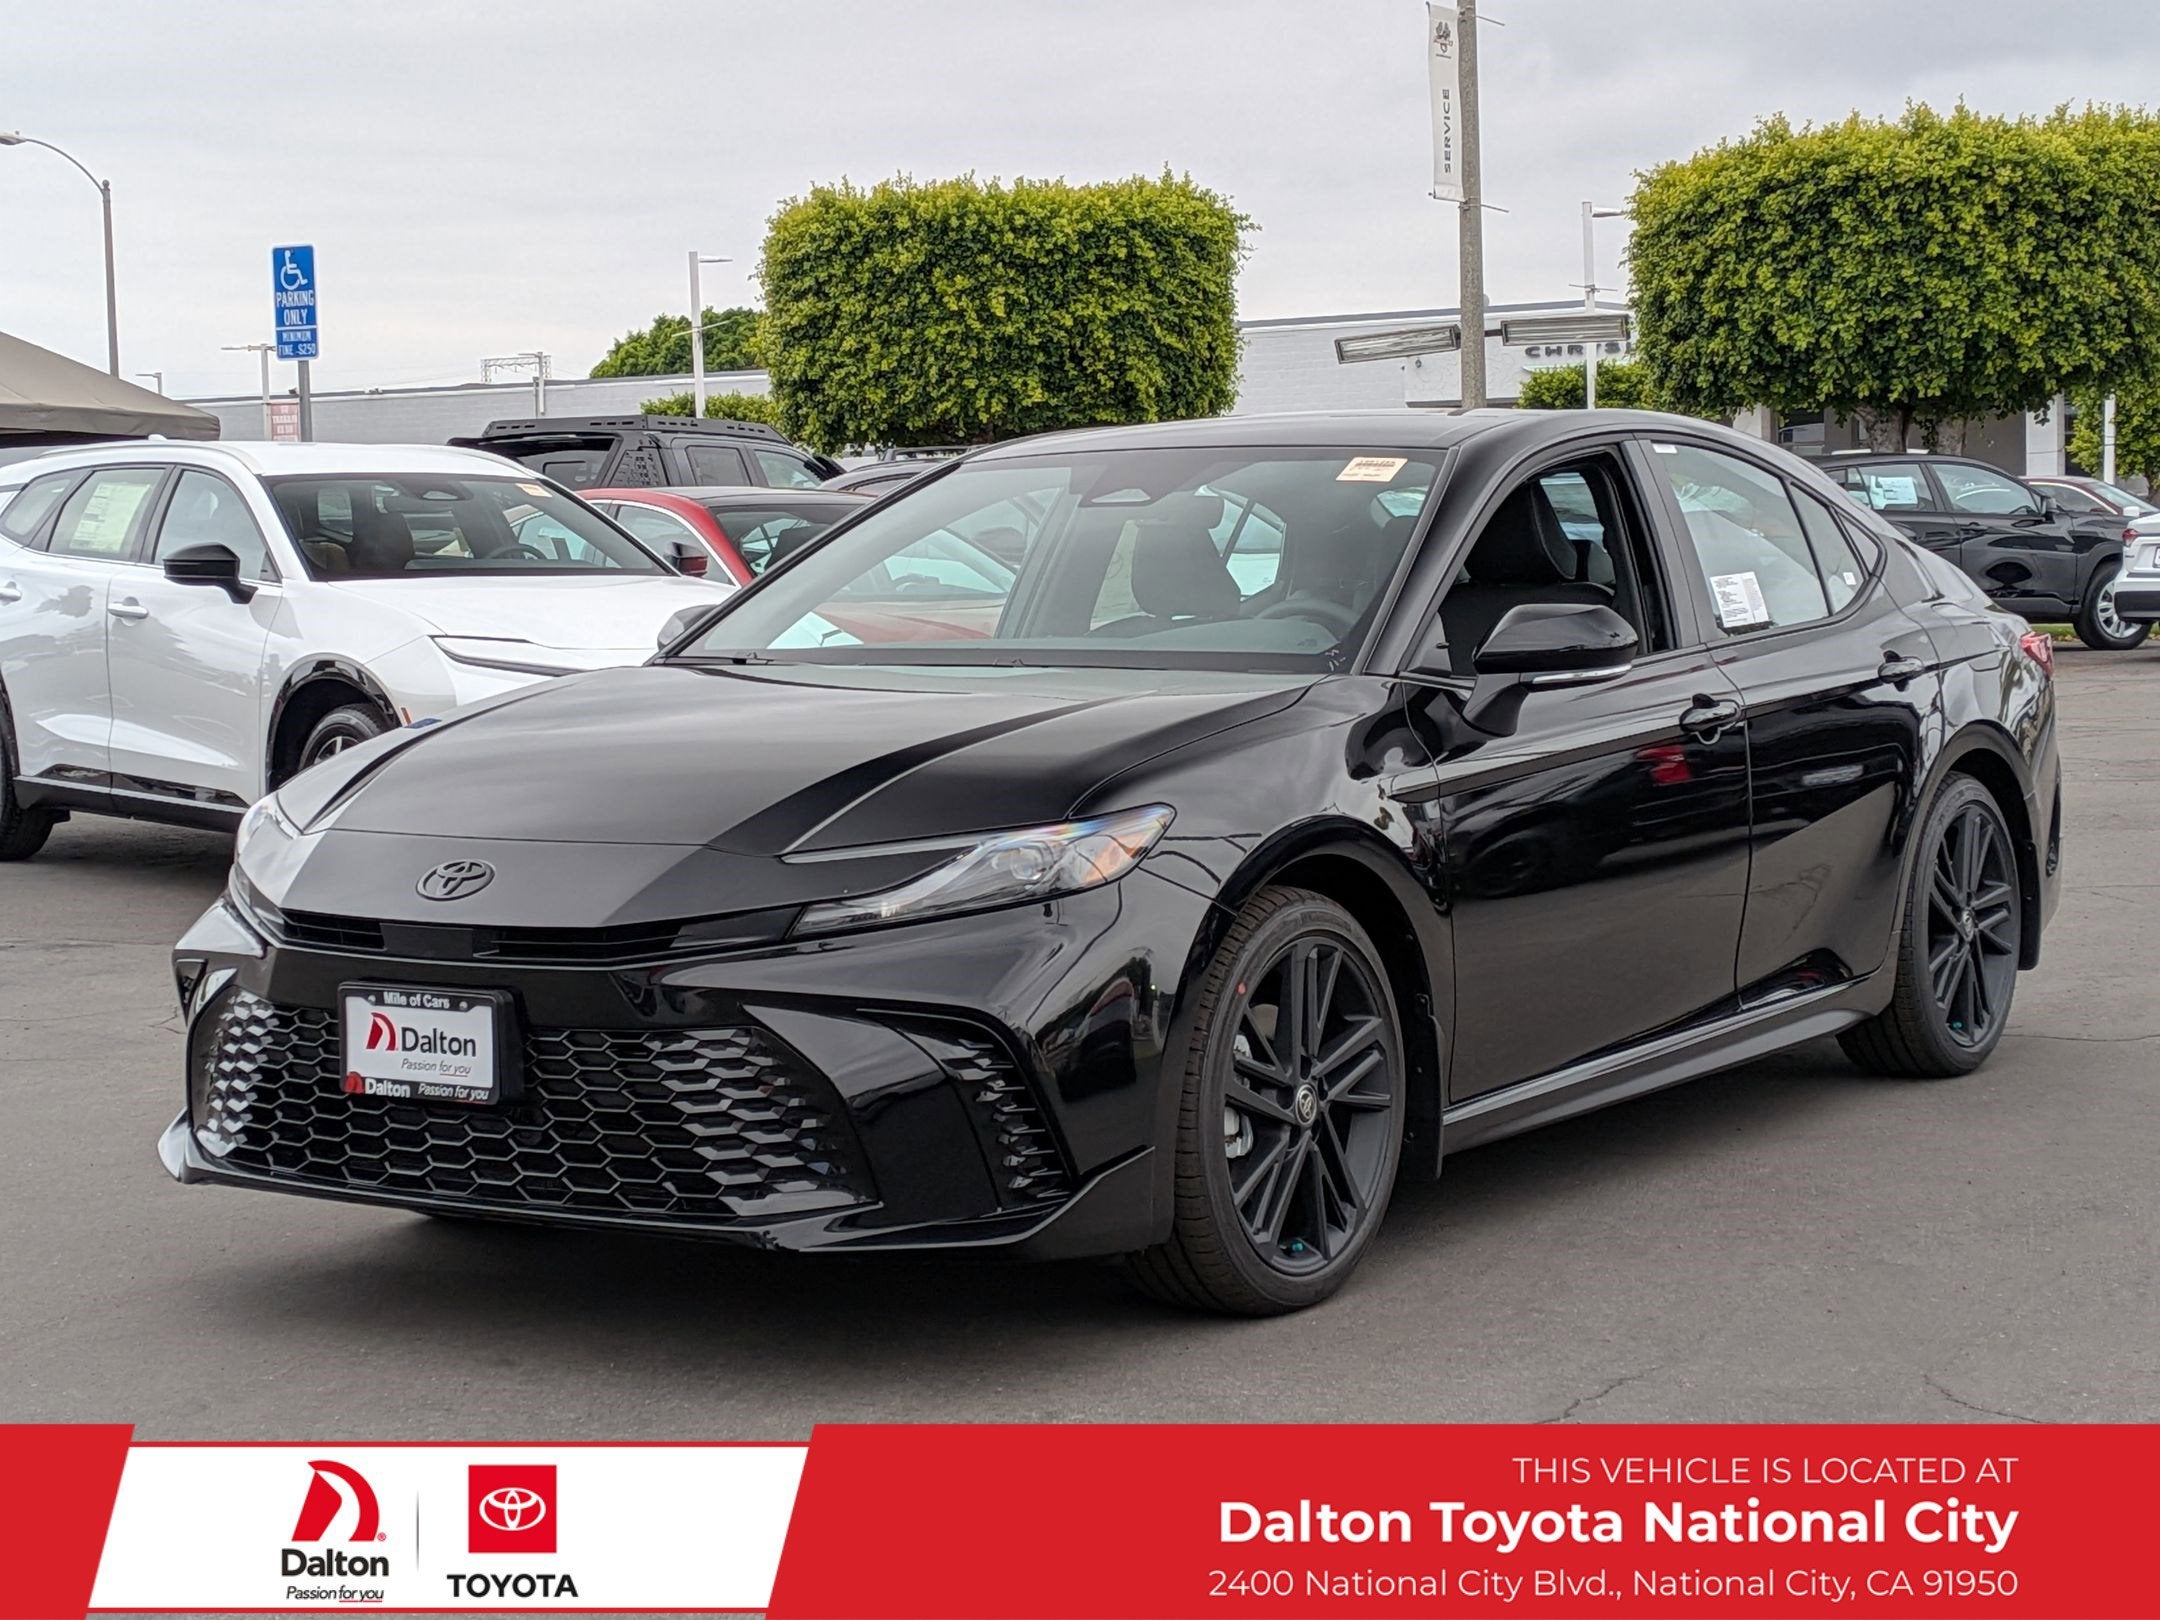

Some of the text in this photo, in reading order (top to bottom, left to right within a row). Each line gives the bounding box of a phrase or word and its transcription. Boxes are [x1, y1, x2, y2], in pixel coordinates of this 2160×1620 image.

[1442, 89, 1451, 174] SERVICE
[276, 289, 314, 307] PARKING
[284, 308, 308, 325] ONLY
[383, 991, 450, 1009] Mile of Cars
[401, 1026, 477, 1057] Dalton
[401, 1058, 472, 1076] Passion for you
[365, 1077, 490, 1102] Dalton Passion for you
